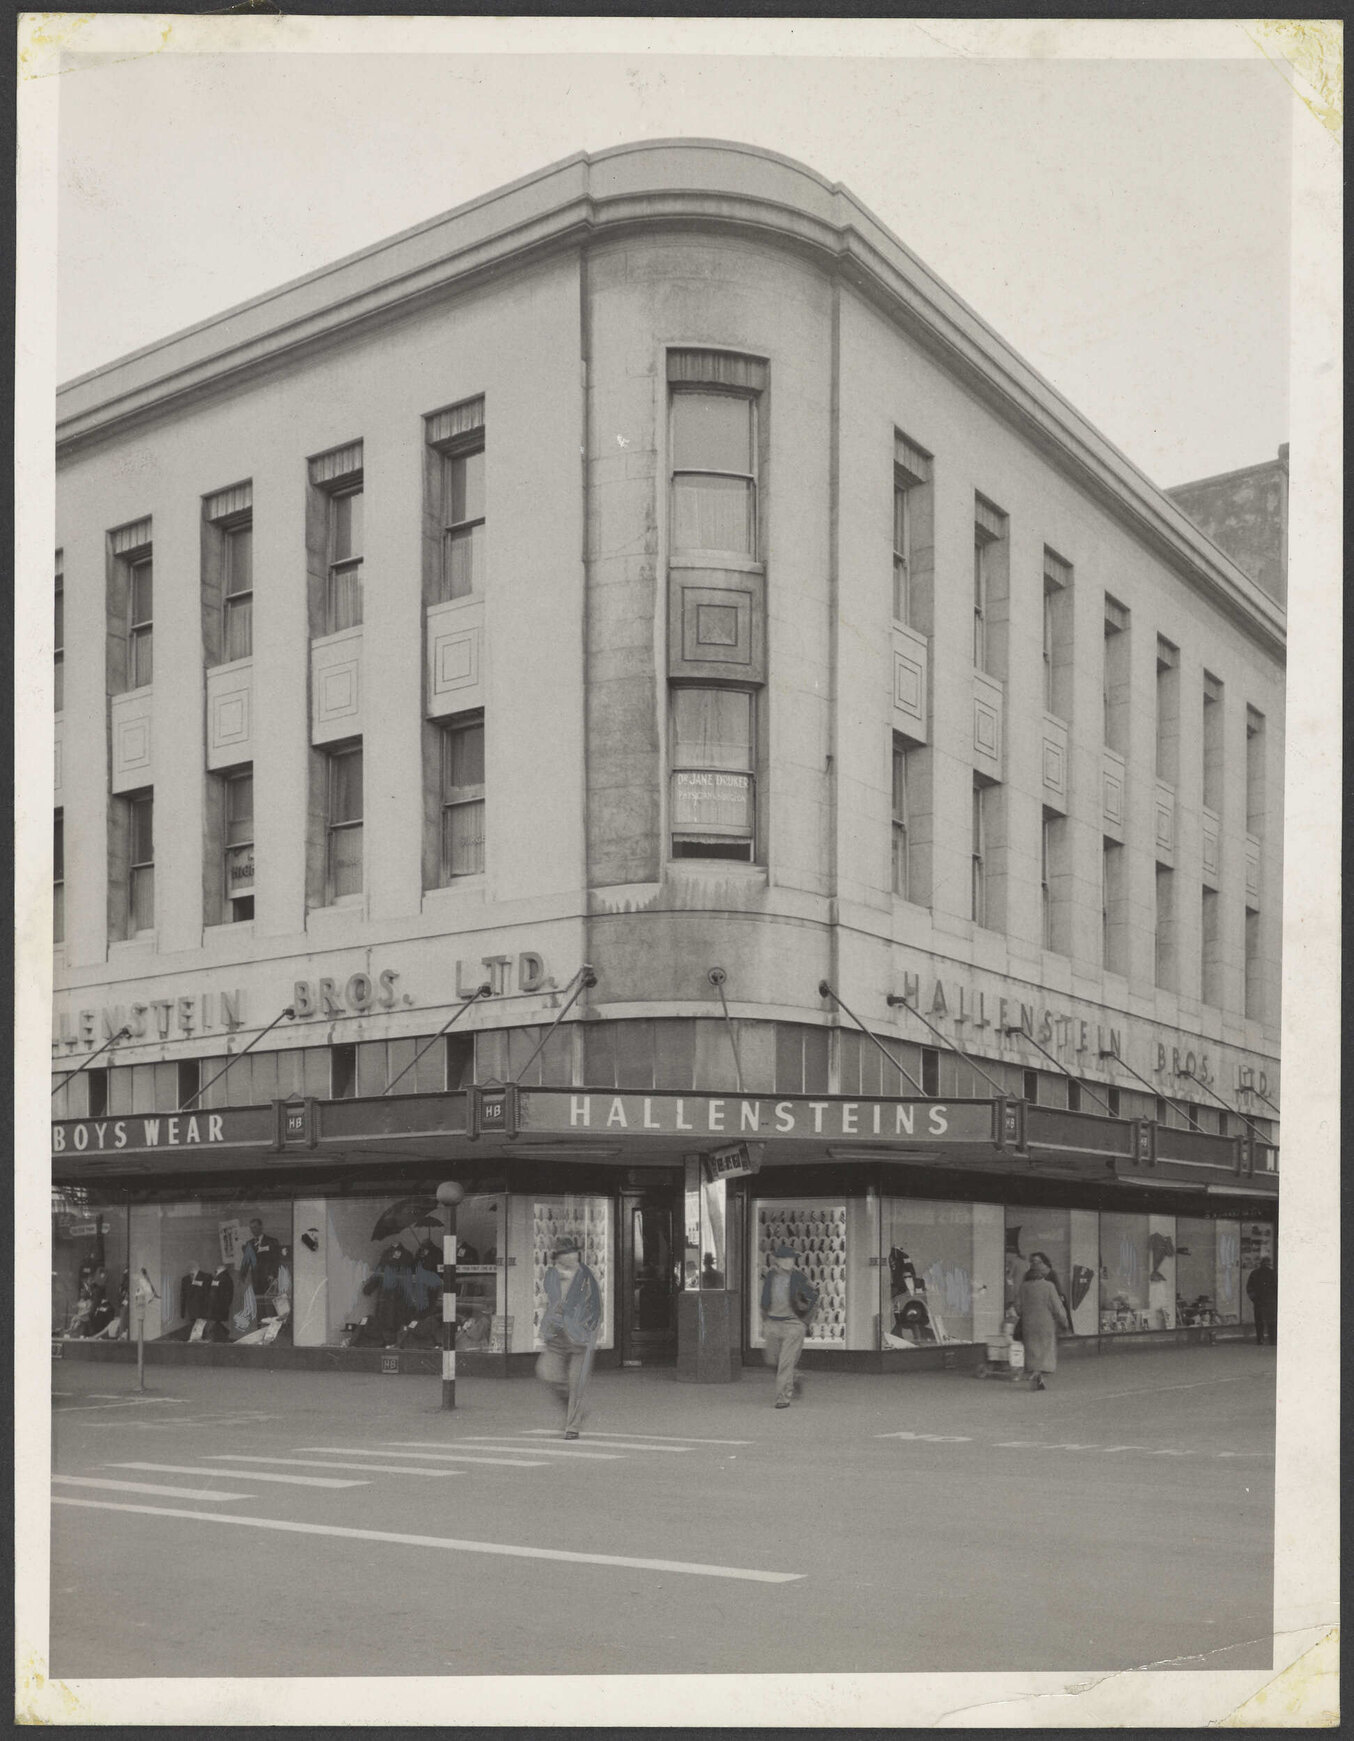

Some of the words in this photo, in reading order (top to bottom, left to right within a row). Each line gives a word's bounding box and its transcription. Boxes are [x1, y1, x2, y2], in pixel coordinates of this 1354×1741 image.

[293, 968, 414, 1018] BROS.
[456, 951, 559, 1000] LTD.
[904, 970, 1121, 1058] HALLENSTEIN
[288, 1117, 302, 1129] HB
[486, 1104, 501, 1118] HB
[569, 1095, 949, 1135] HALLENSTEINS
[53, 1121, 128, 1151] BOYS
[144, 1114, 224, 1147] WEAR
